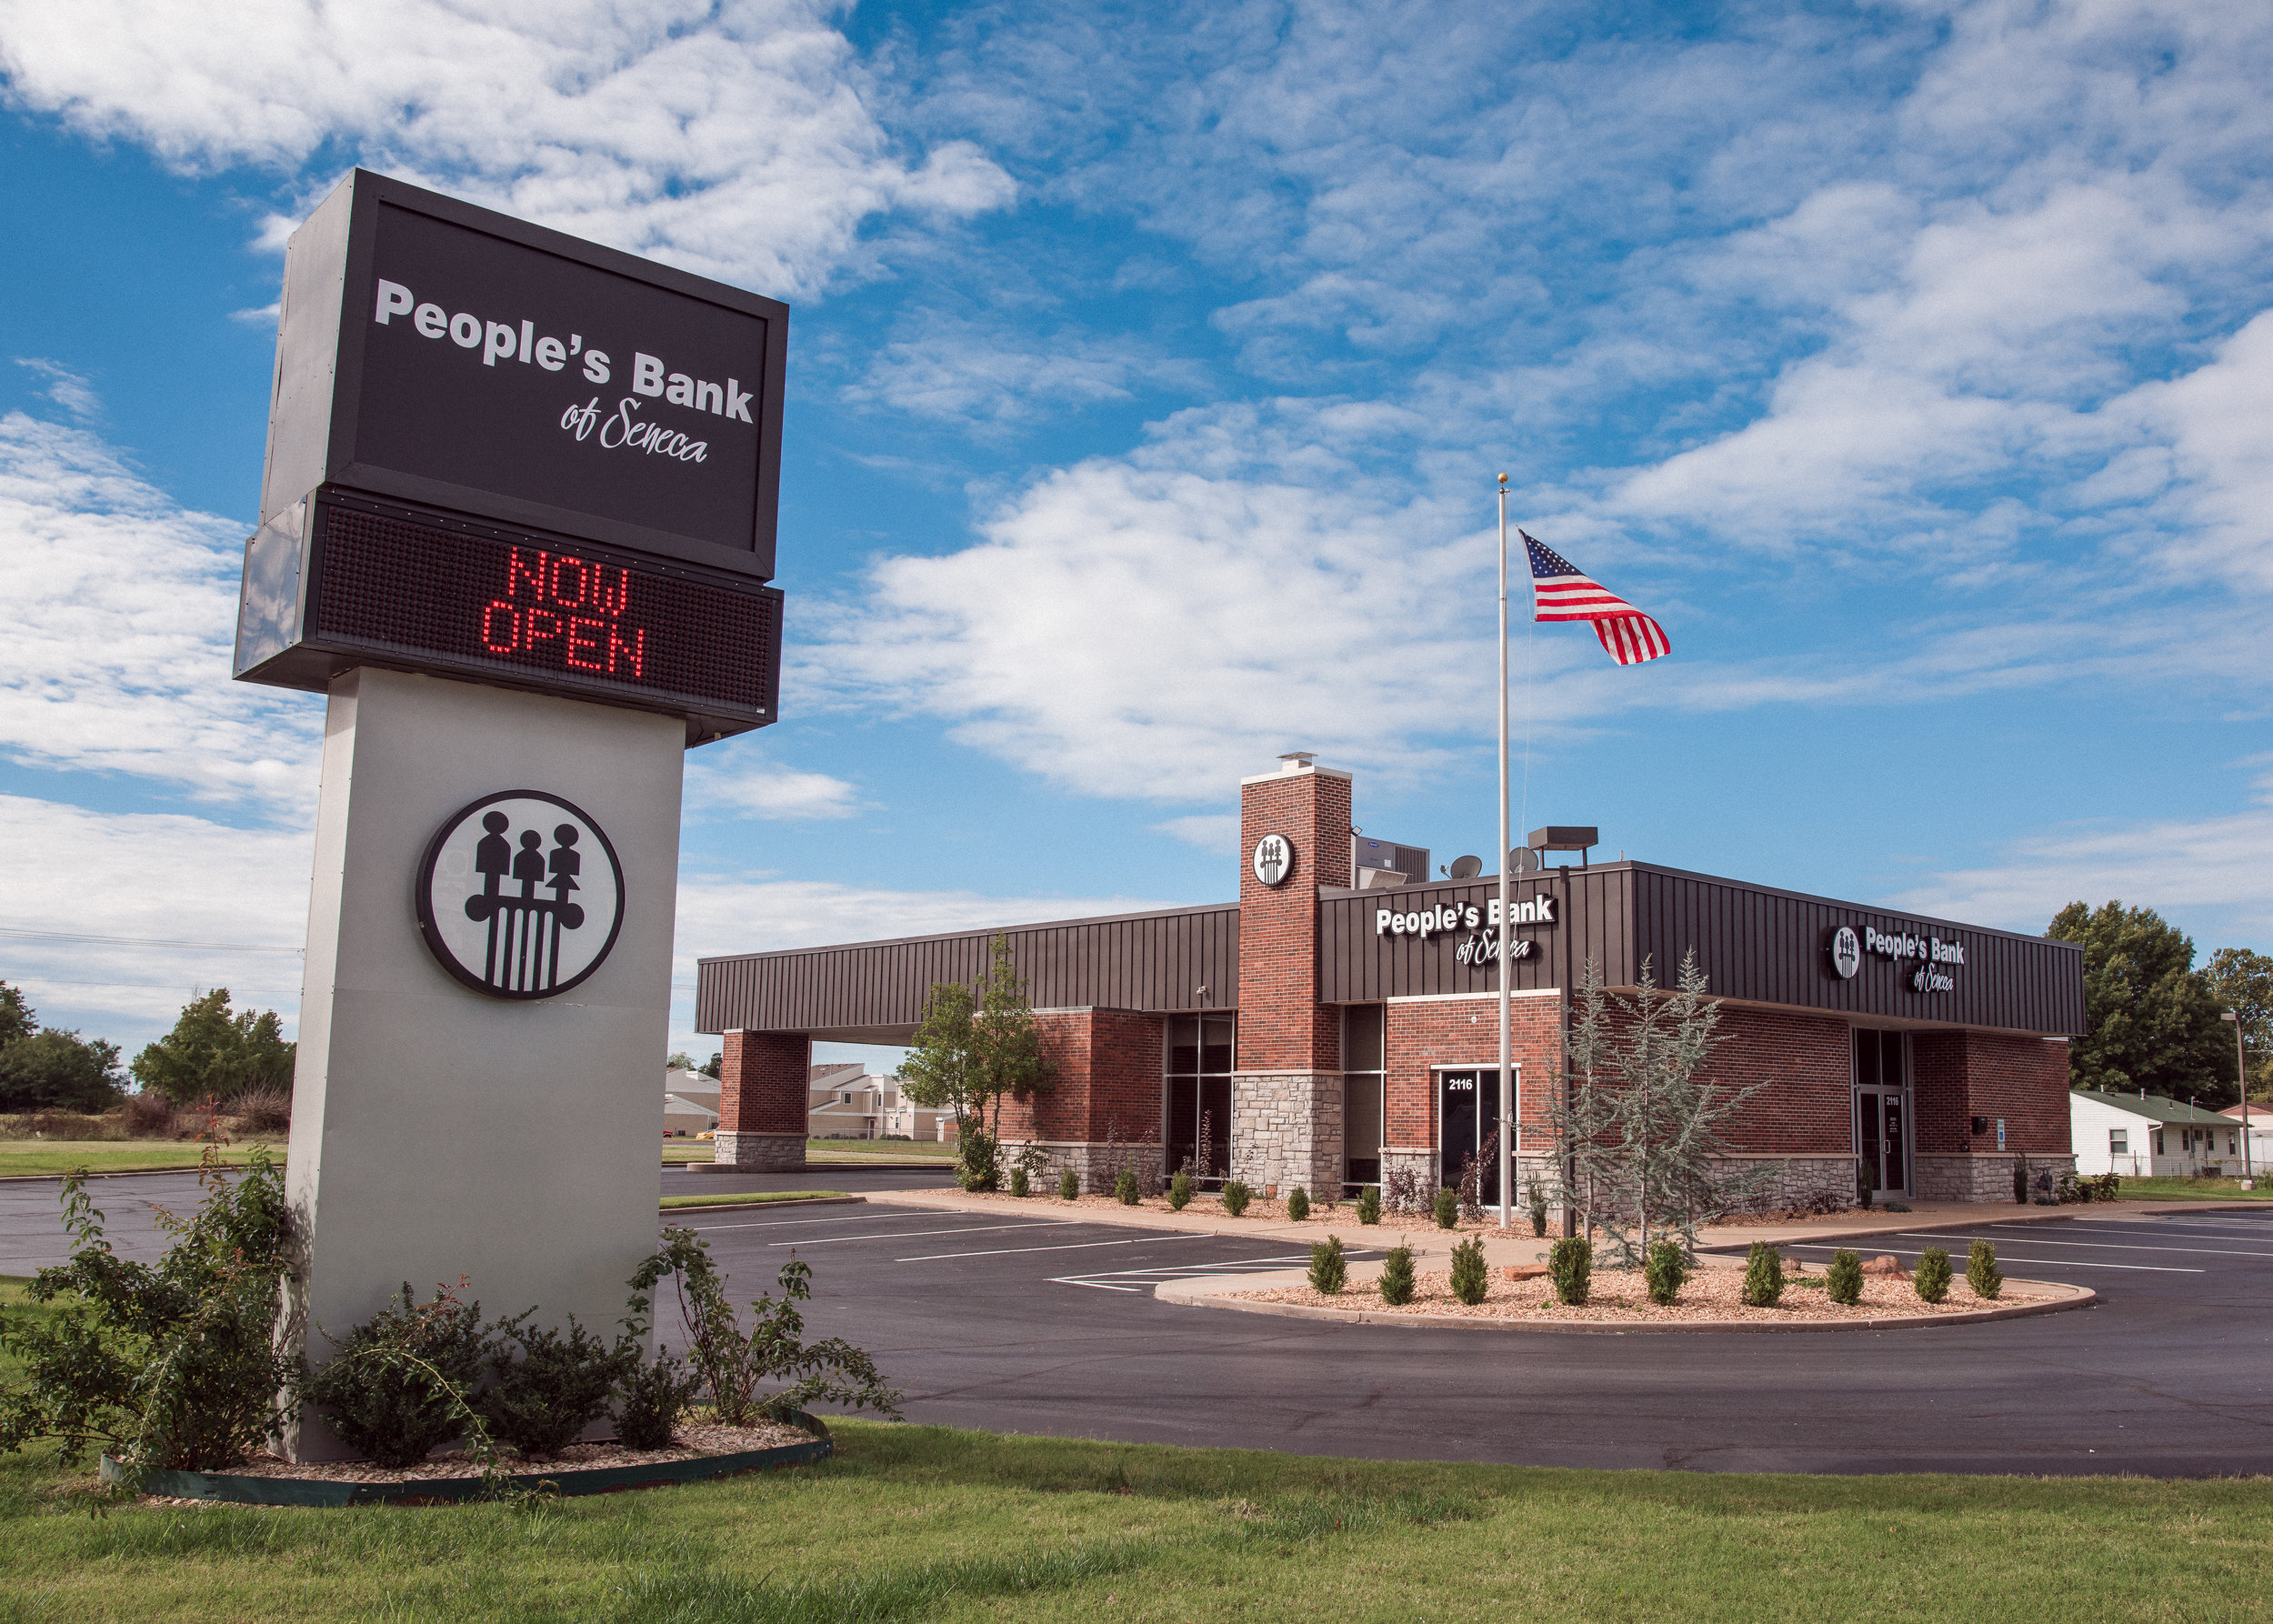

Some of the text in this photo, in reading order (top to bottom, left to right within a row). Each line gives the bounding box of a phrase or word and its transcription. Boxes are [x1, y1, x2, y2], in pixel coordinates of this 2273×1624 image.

[633, 352, 754, 424] Bank
[561, 397, 708, 462] of Seneca
[509, 546, 627, 616] NOW
[483, 601, 644, 677] OPEN
[1487, 894, 1554, 925] Bank
[1457, 935, 1476, 964] of
[1931, 937, 1964, 964] Bank
[1914, 963, 1953, 992] of Seneca
[1448, 1078, 1473, 1090] 2116
[1886, 1096, 1898, 1105] 2116
